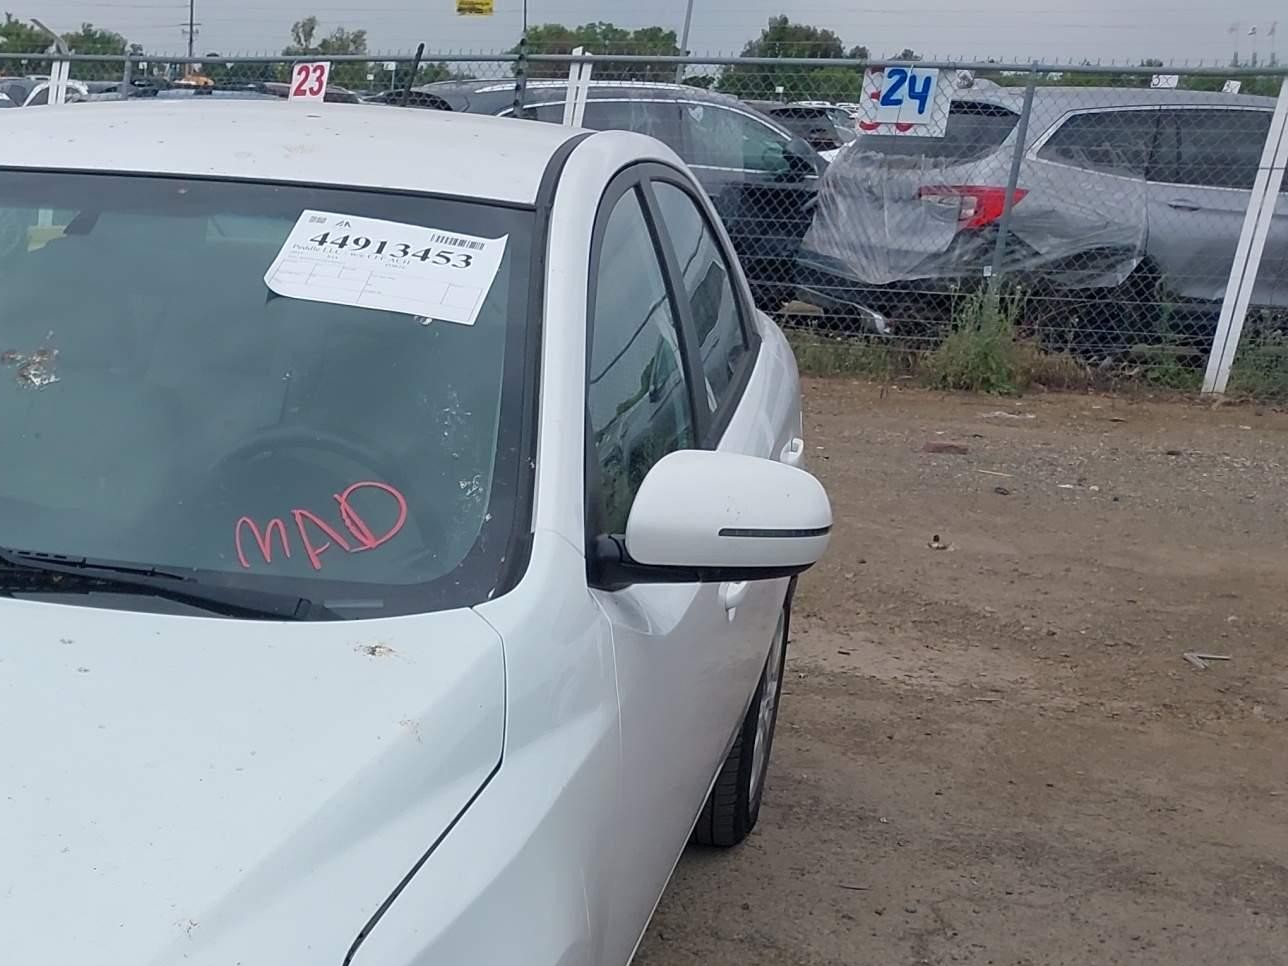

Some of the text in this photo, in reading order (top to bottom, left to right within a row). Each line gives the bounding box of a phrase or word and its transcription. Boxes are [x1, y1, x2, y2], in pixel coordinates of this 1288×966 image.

[293, 64, 325, 97] 23
[880, 68, 932, 115] 24
[309, 231, 474, 269] 44913453
[235, 481, 408, 570] MAD
